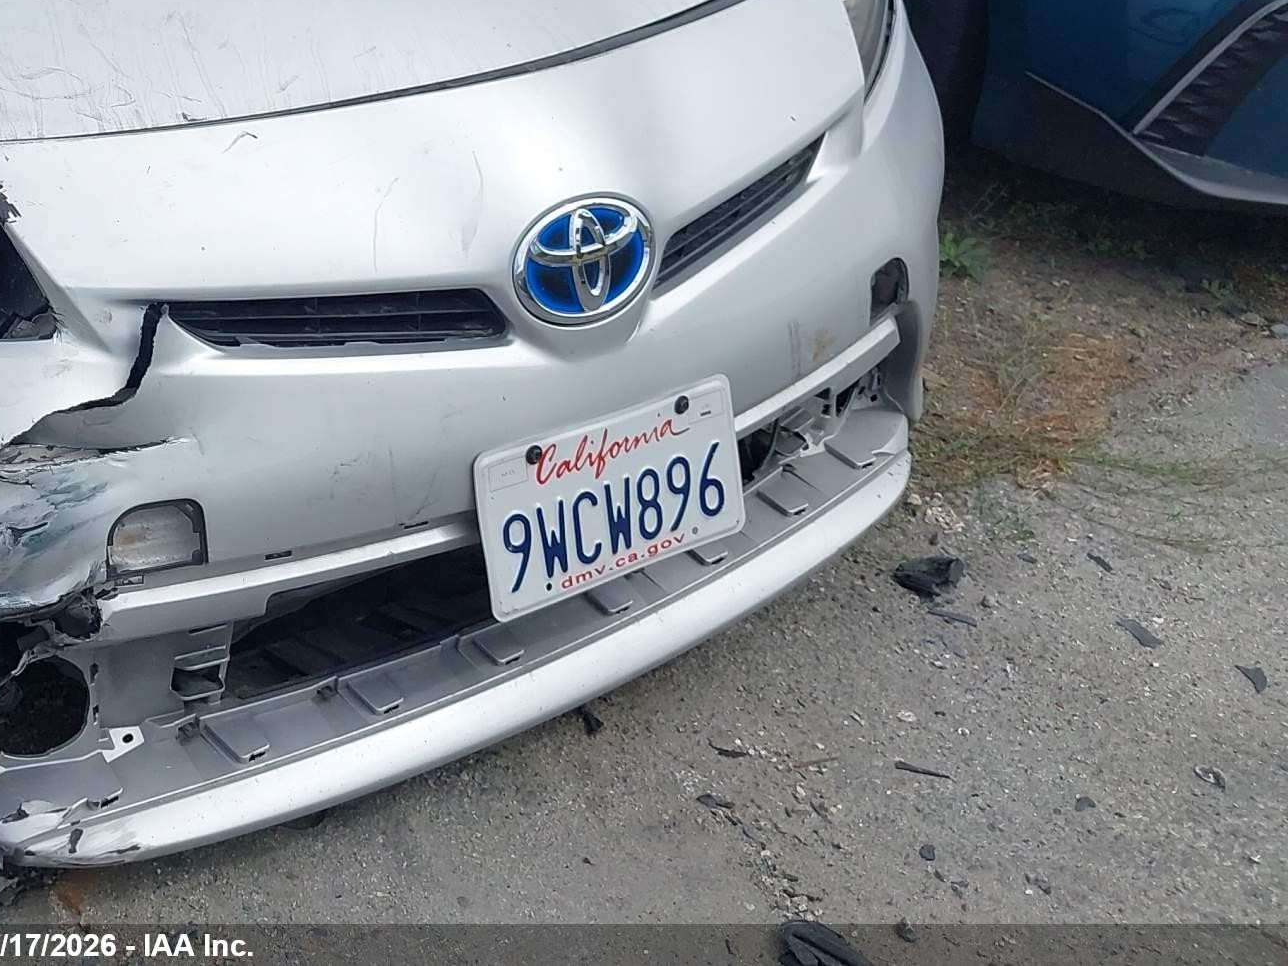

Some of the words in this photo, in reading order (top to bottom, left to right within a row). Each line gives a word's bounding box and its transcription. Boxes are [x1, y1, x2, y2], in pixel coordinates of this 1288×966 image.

[535, 414, 690, 485] California
[502, 441, 726, 594] 9WCW896
[560, 533, 686, 589] dmv.ca.gov
